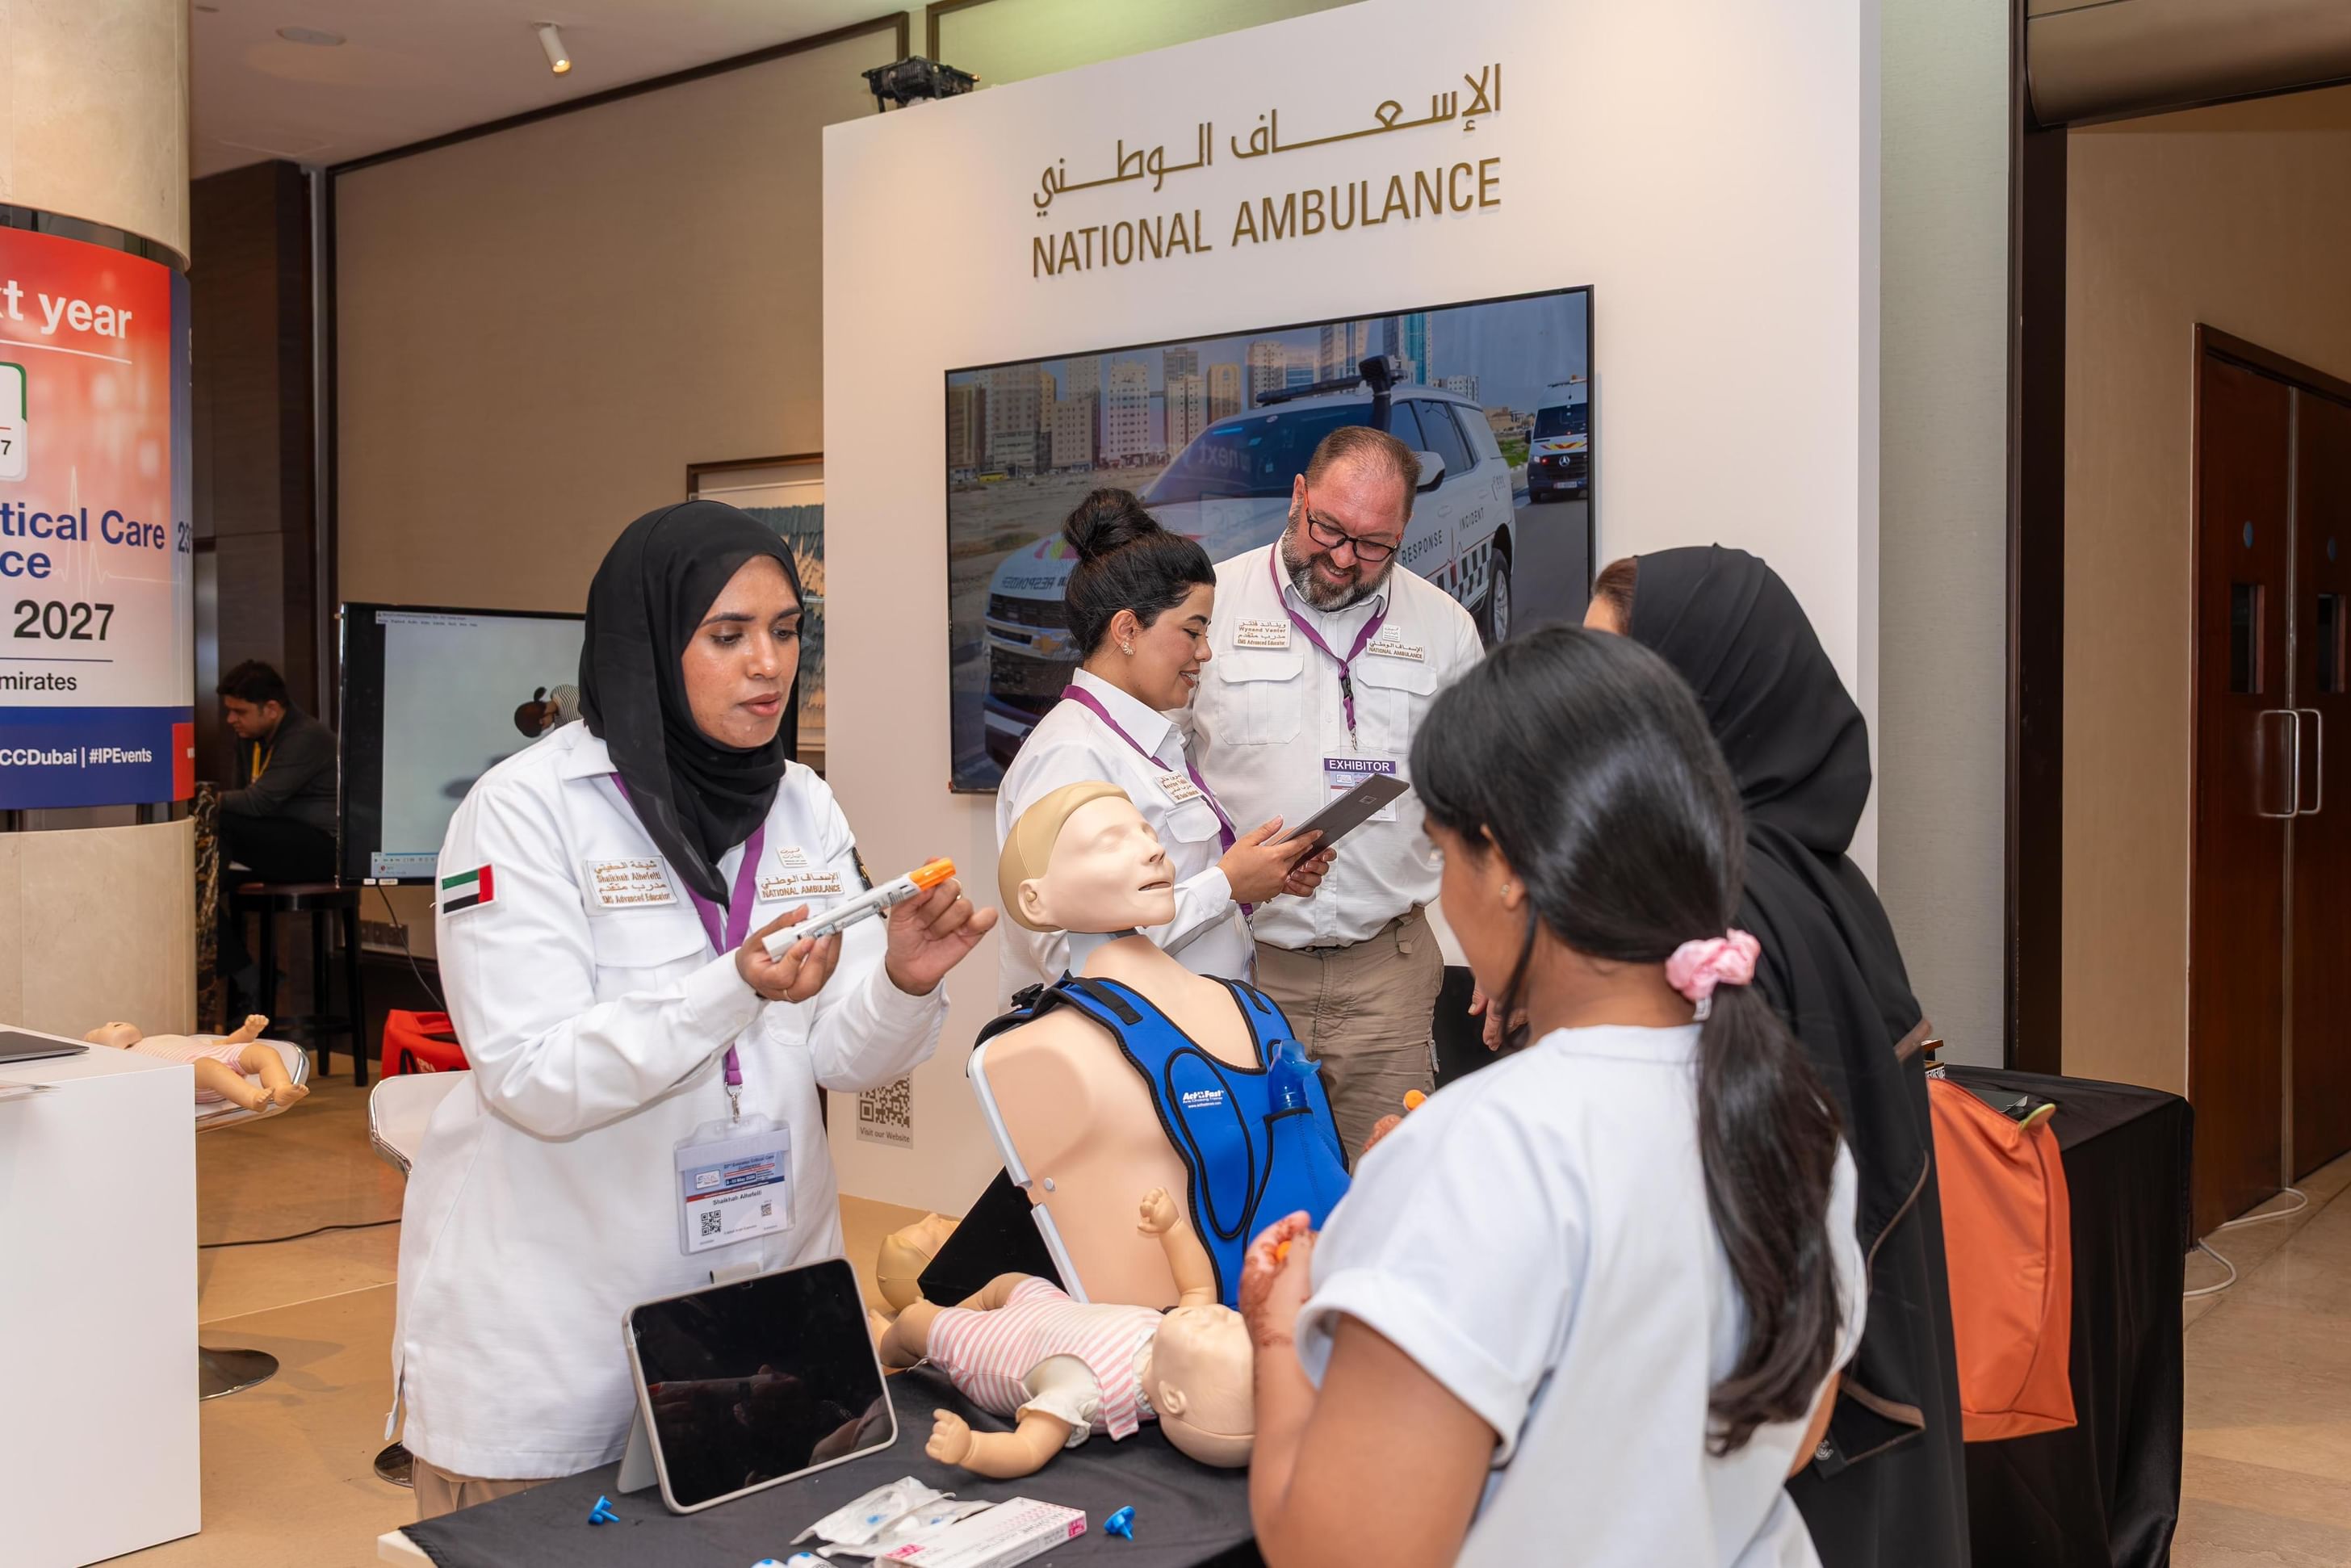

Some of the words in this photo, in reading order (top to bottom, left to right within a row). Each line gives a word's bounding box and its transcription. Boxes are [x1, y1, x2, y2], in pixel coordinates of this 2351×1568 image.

[1033, 209, 1212, 279] NATIONAL
[1232, 157, 1501, 247] AMBULANCE
[38, 292, 132, 339] year
[0, 502, 87, 541] tical
[101, 509, 165, 549] Care
[1459, 507, 1484, 531] INCIDENT
[1402, 530, 1442, 566] RESPONSE
[0, 551, 51, 579] ce
[14, 599, 114, 640] 2027
[1369, 647, 1392, 655] NATIONAL
[1393, 651, 1423, 659] AMBULANCE
[0, 672, 77, 690] mirates
[0, 748, 77, 765] CCDubai
[89, 748, 152, 764] #IPEvents
[1329, 760, 1389, 771] EXHIBITOR
[762, 887, 799, 898] NATIONAL
[801, 884, 841, 895] AMBULANCE
[860, 1126, 873, 1137] Visit
[886, 1131, 910, 1142] Website
